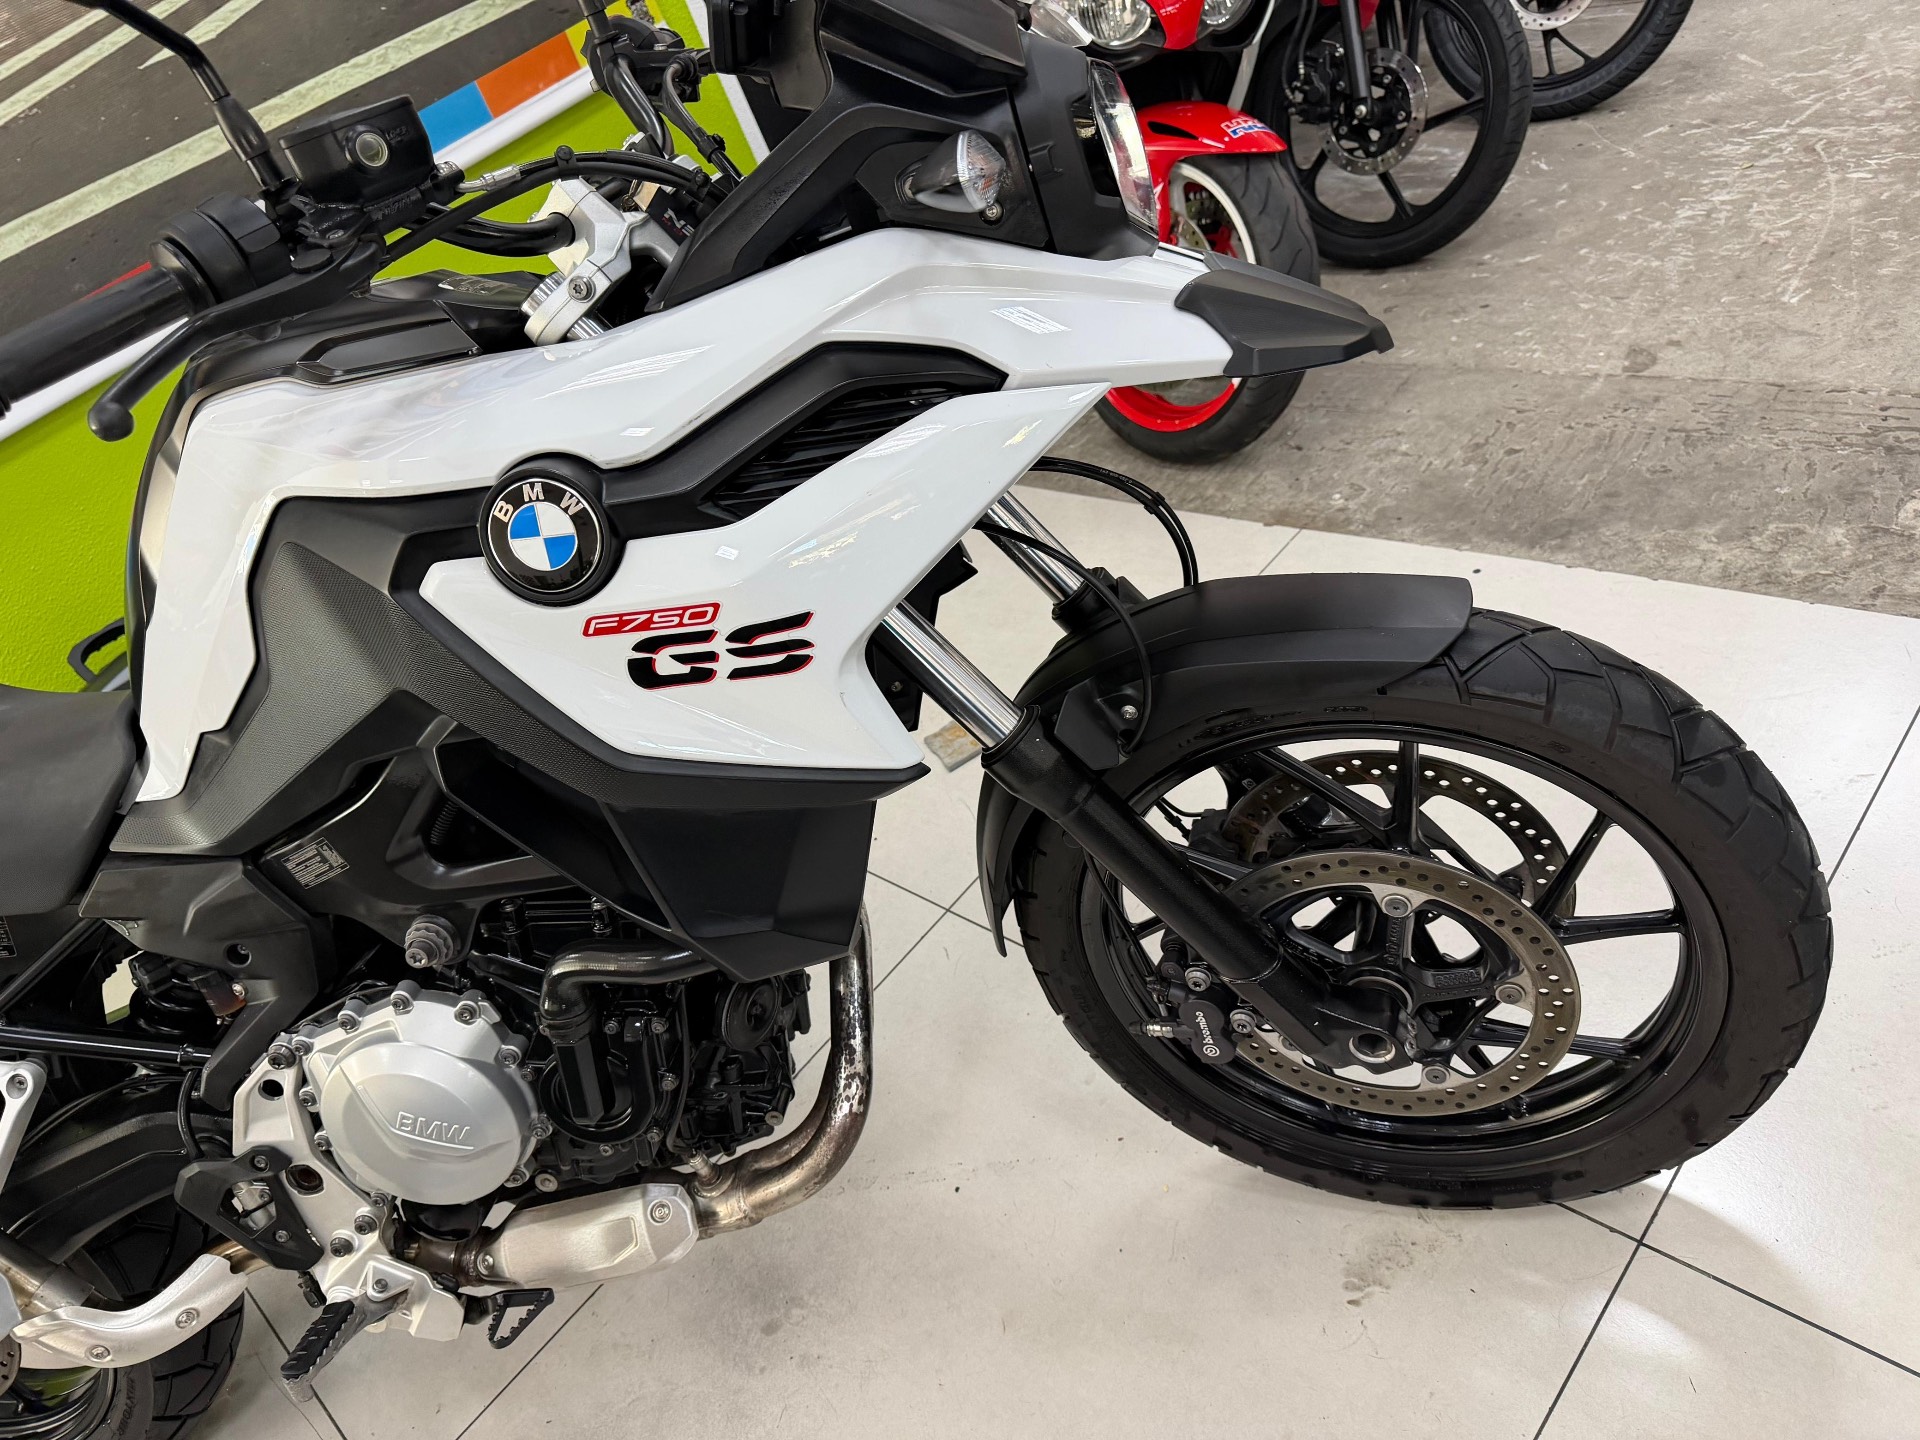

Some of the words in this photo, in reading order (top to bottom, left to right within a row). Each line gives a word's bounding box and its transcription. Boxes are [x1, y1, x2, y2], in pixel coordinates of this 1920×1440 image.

[493, 482, 585, 523] BMW
[587, 605, 715, 635] F750
[627, 610, 816, 691] GS
[1195, 1011, 1214, 1044] brembo
[396, 1110, 471, 1144] BMW
